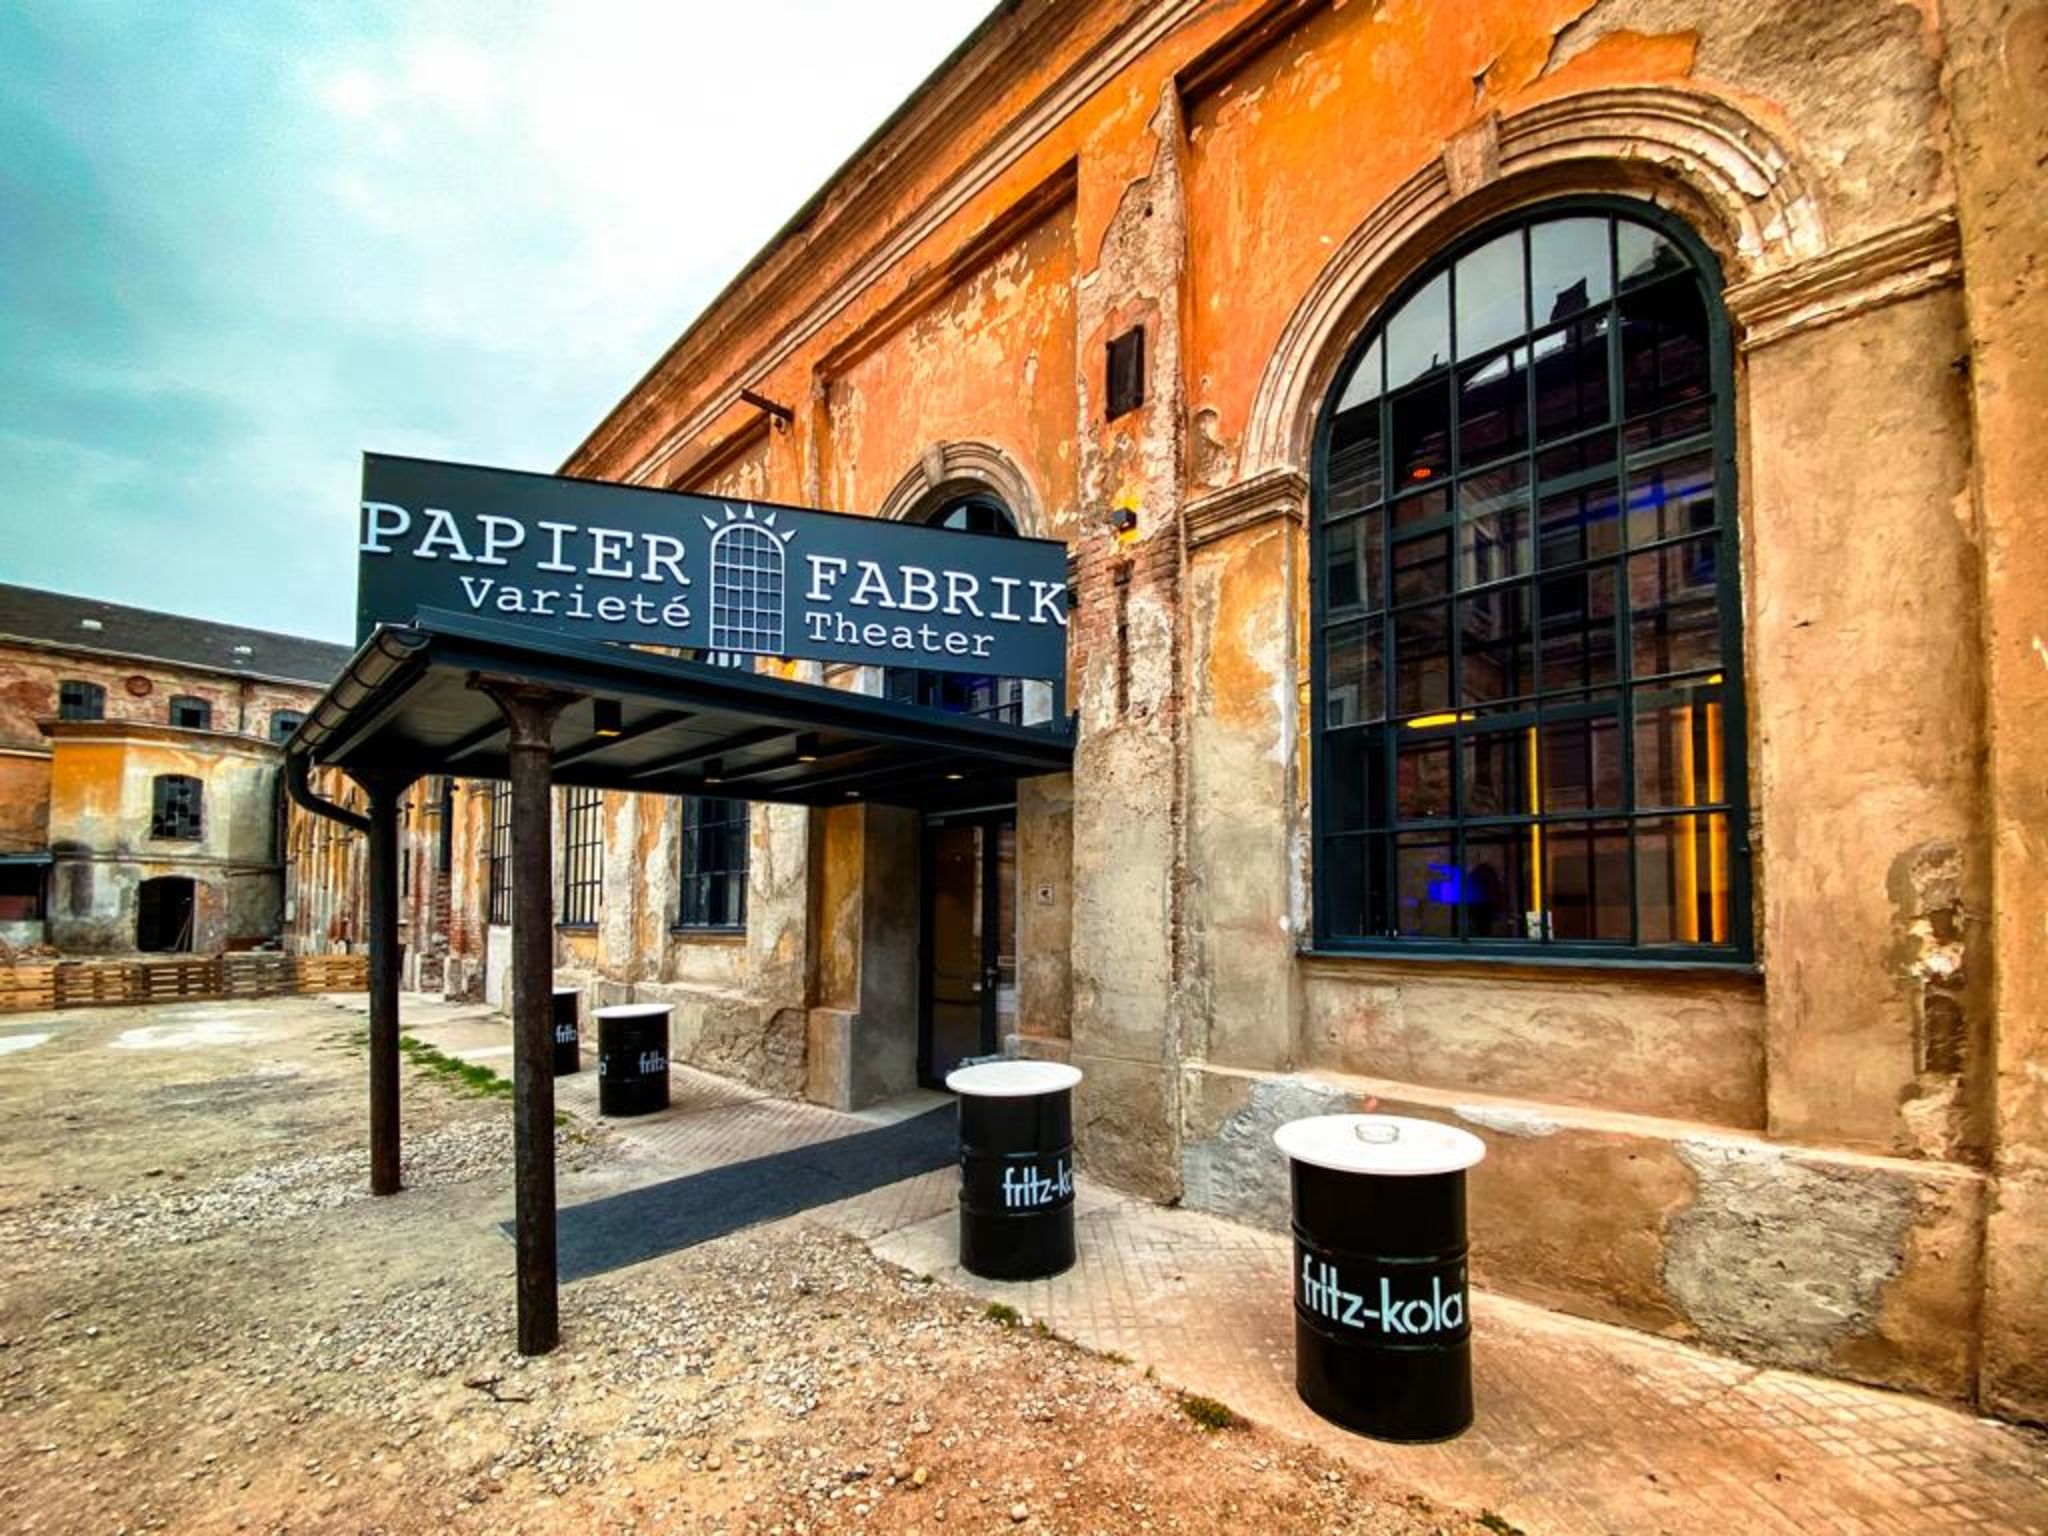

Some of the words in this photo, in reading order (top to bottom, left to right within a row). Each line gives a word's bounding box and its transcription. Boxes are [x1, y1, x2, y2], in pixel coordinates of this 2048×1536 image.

[359, 501, 692, 586] PAPIER
[805, 554, 1067, 626] FABRIK
[459, 575, 692, 628] Varieté
[804, 611, 994, 657] Theater
[1302, 1253, 1463, 1334] fritz-kola
